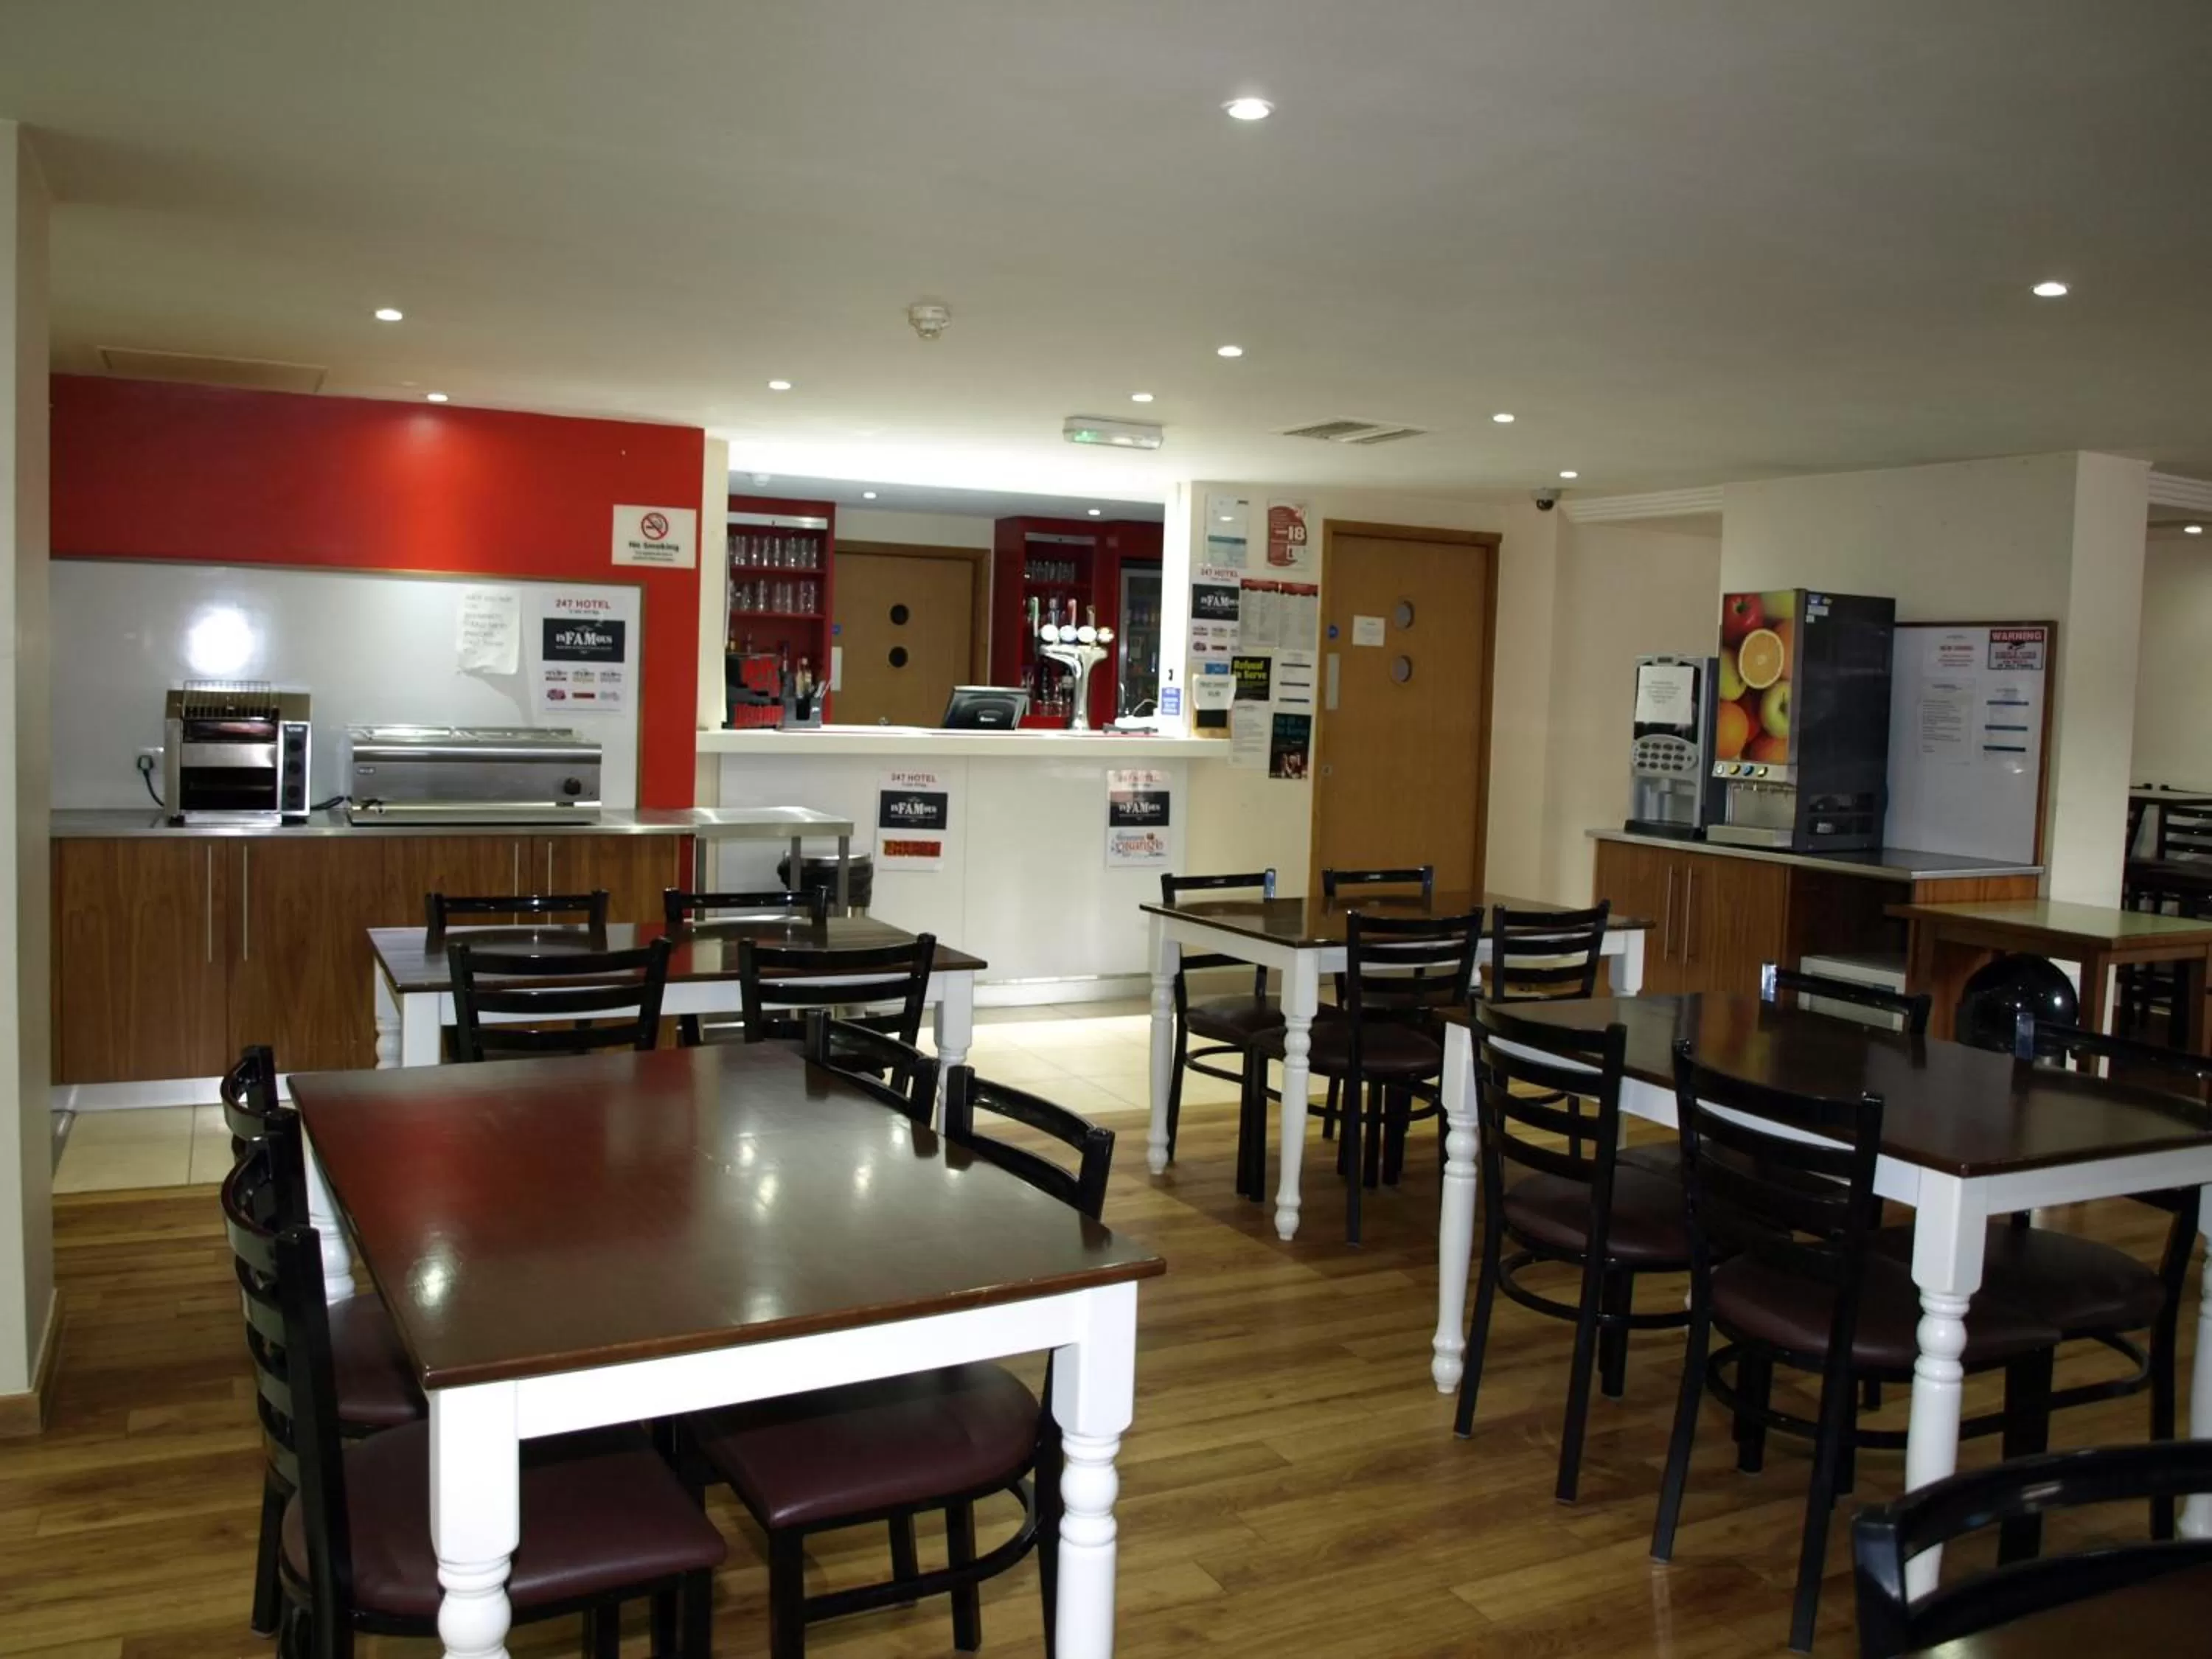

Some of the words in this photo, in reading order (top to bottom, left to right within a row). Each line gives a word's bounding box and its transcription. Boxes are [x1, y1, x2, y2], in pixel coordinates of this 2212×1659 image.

[644, 542, 679, 552] Smoking
[555, 599, 573, 608] 247
[576, 599, 611, 610] HOTEL
[1992, 631, 2042, 641] WARNING
[908, 773, 936, 783] HOTEL
